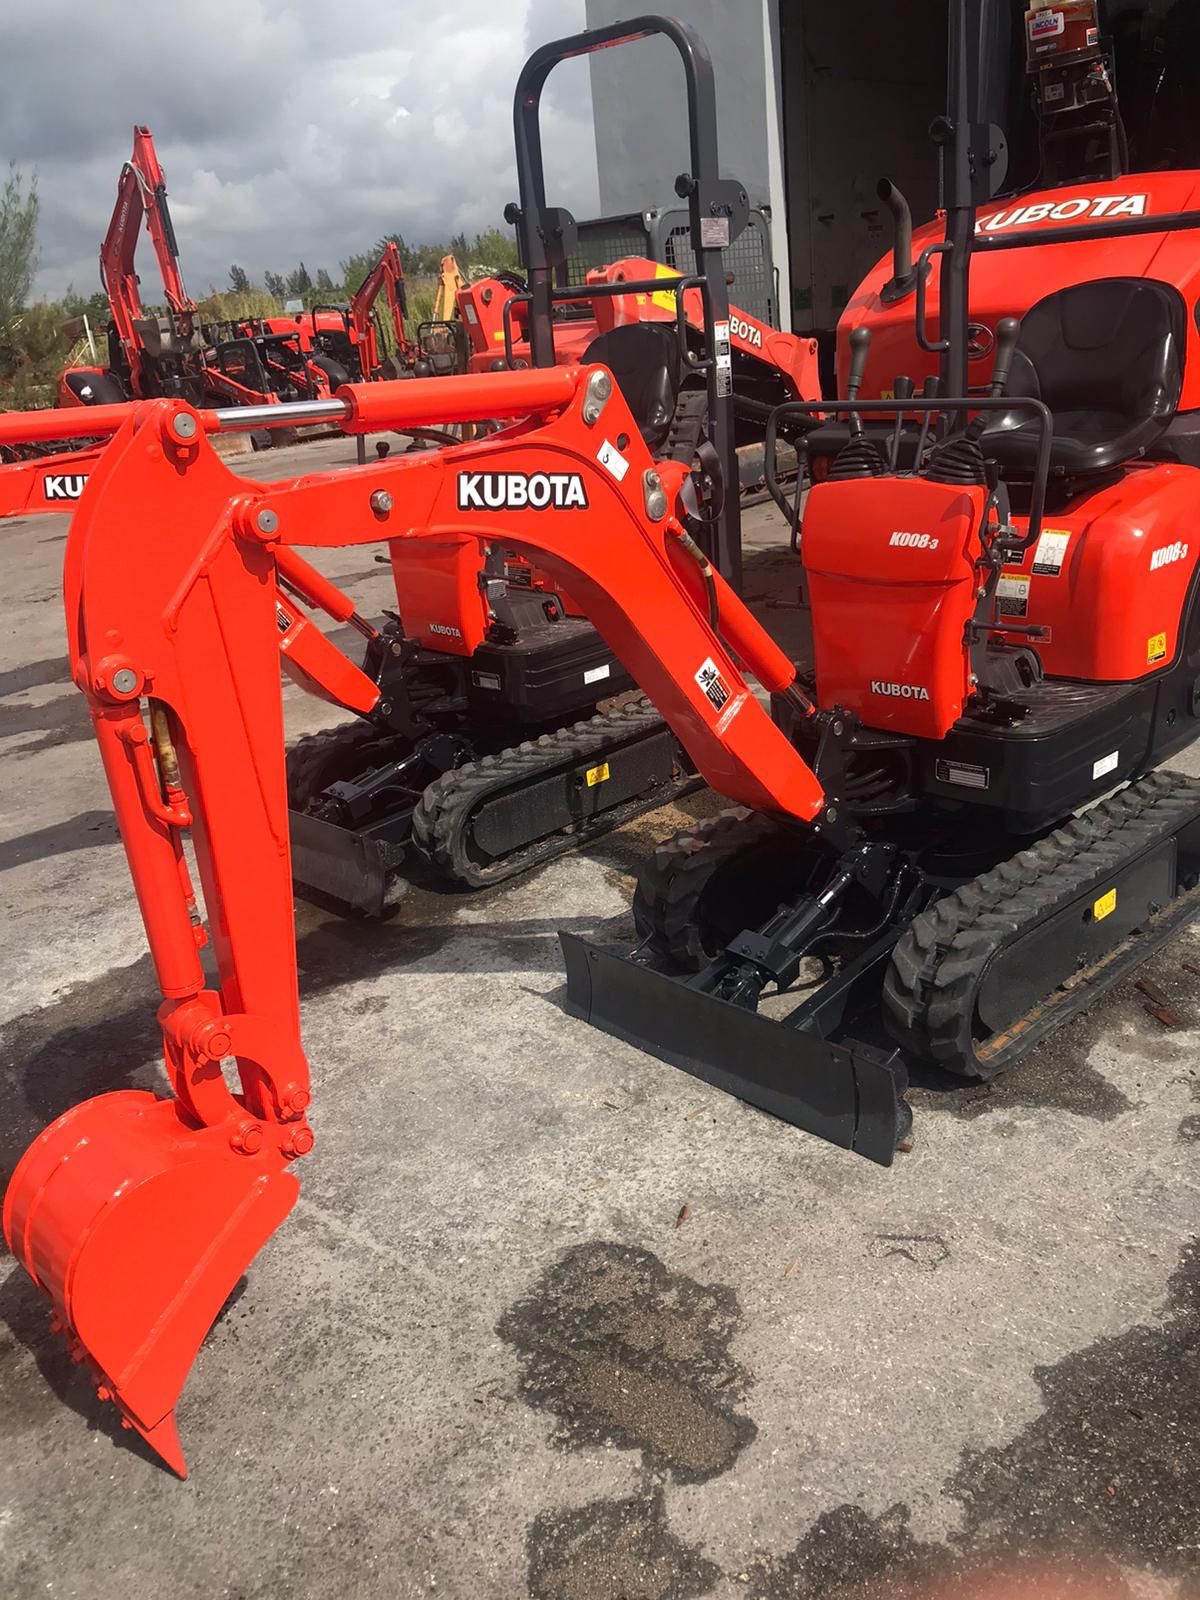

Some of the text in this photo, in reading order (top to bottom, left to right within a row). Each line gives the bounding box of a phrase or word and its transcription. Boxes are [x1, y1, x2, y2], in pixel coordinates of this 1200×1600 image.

[729, 314, 762, 348] BOTA
[459, 474, 587, 507] KUBOTA
[889, 531, 939, 549] K008-3
[429, 623, 462, 637] KUBOTA
[871, 681, 929, 700] KUBOTA
